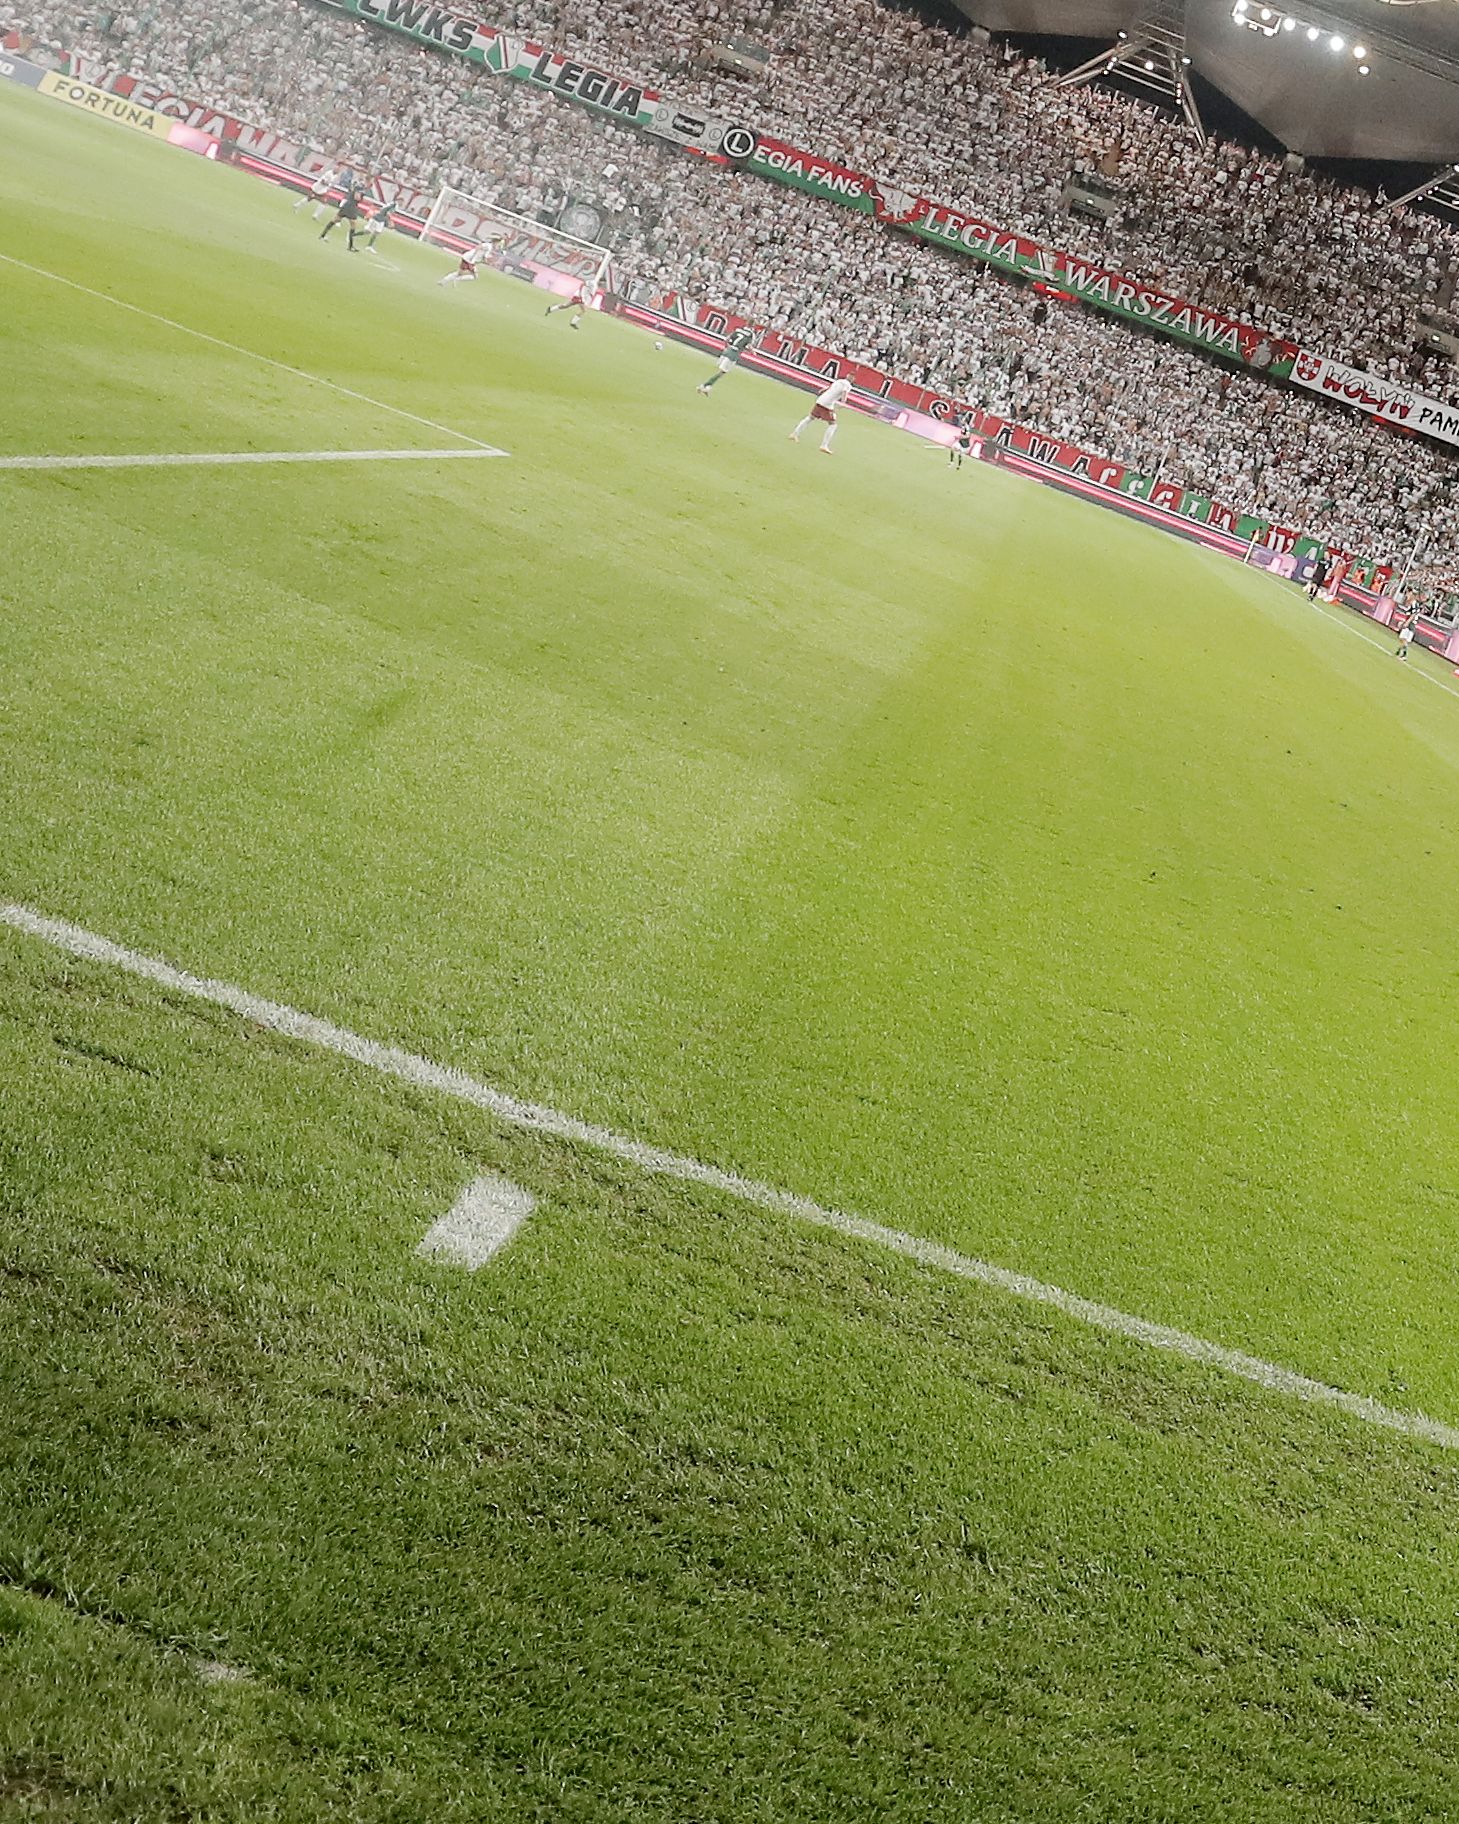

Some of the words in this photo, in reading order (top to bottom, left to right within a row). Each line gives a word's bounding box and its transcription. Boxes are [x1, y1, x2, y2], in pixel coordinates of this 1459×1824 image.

[52, 79, 155, 130] FORTUNA
[529, 50, 642, 118] LEGIA
[806, 165, 865, 198] FANS
[920, 207, 1018, 266] LEGIA
[1062, 259, 1241, 355] WARSZAWA
